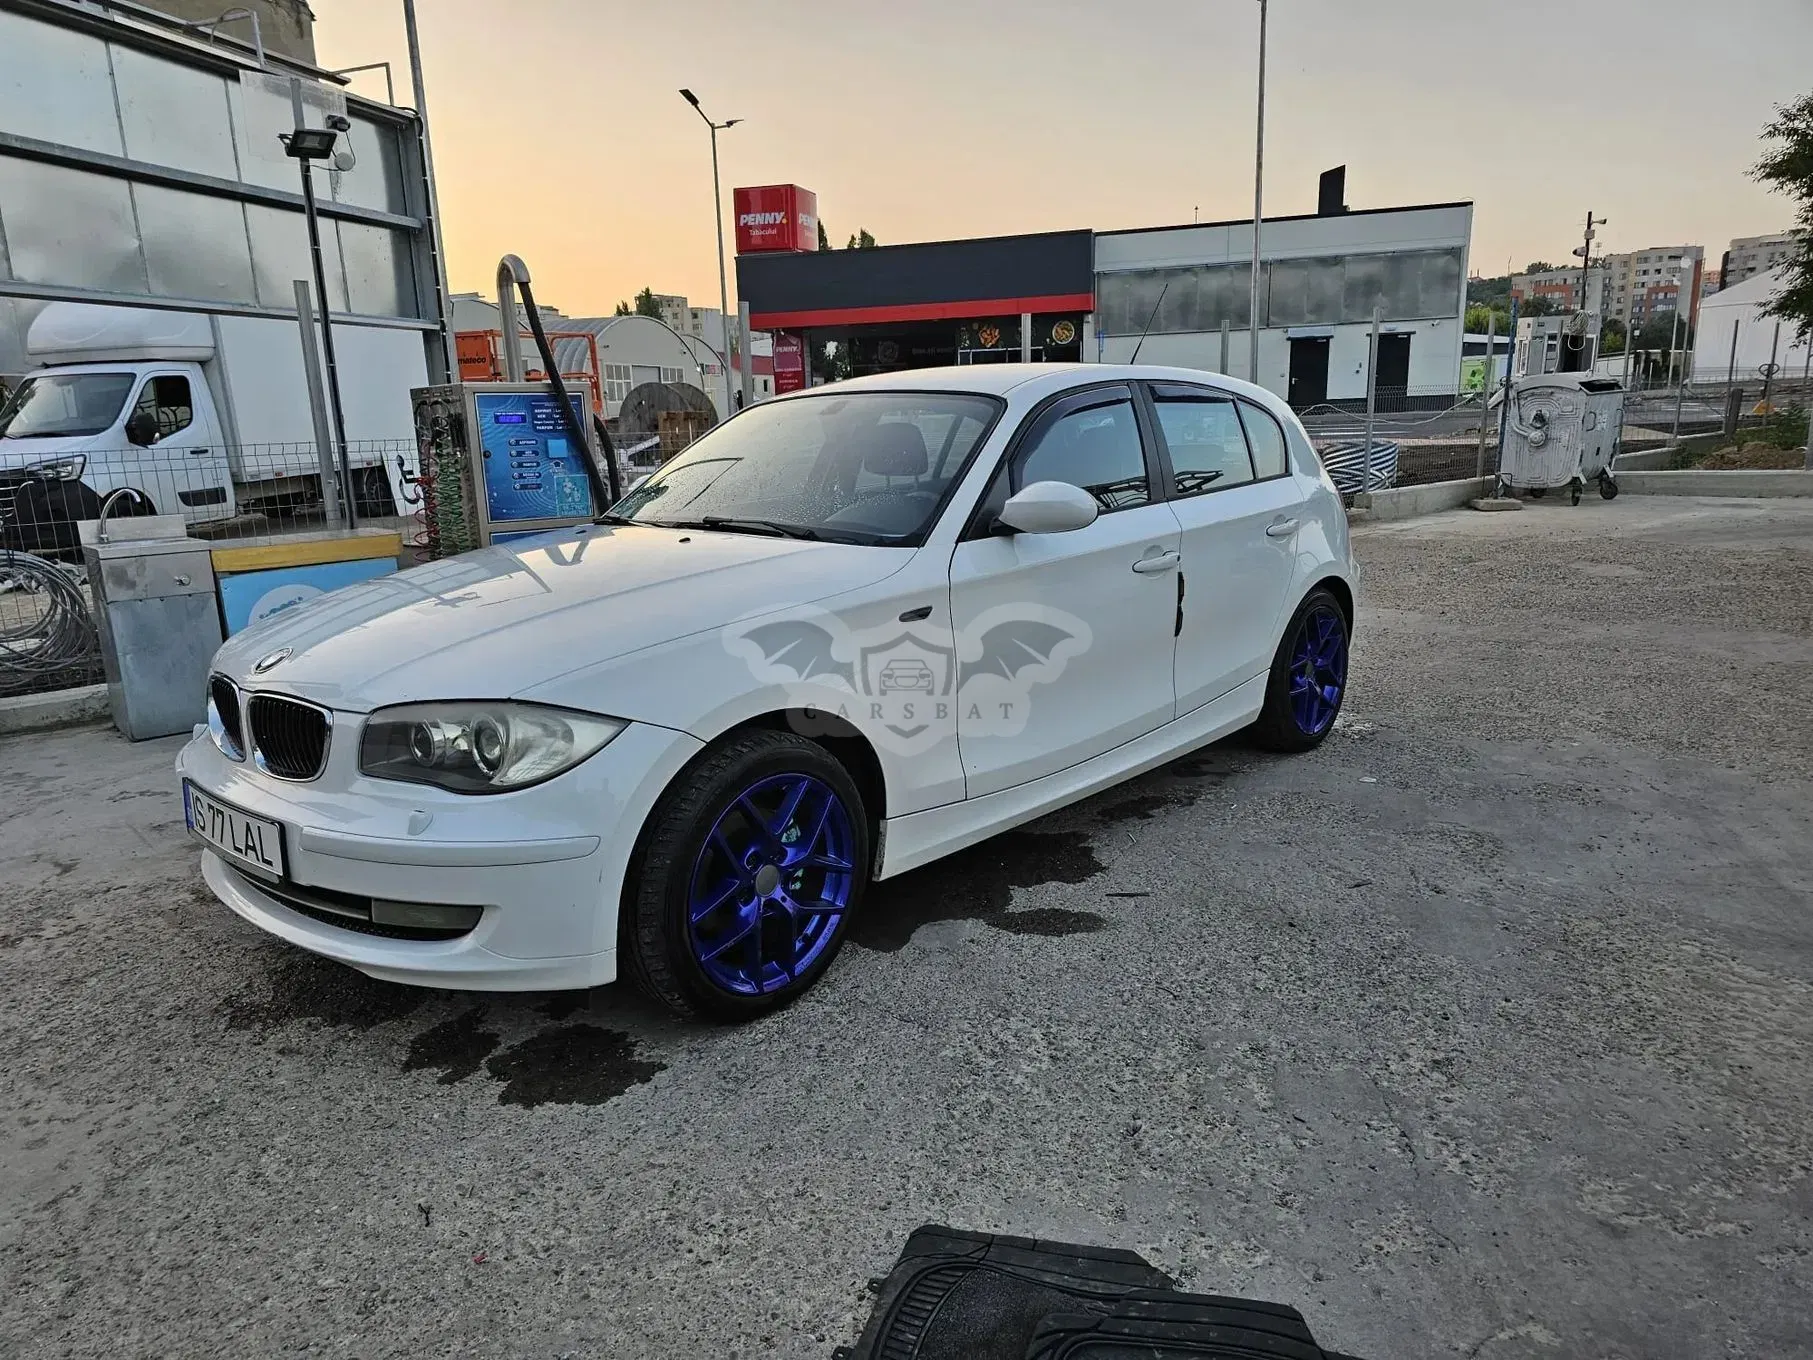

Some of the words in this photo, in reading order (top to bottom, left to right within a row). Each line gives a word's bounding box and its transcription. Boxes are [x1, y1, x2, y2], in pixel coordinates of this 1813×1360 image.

[749, 227, 777, 236] Tabacului
[458, 356, 487, 365] mateco
[191, 792, 206, 832] IS
[207, 802, 225, 843] 77
[228, 813, 274, 867] LAL
